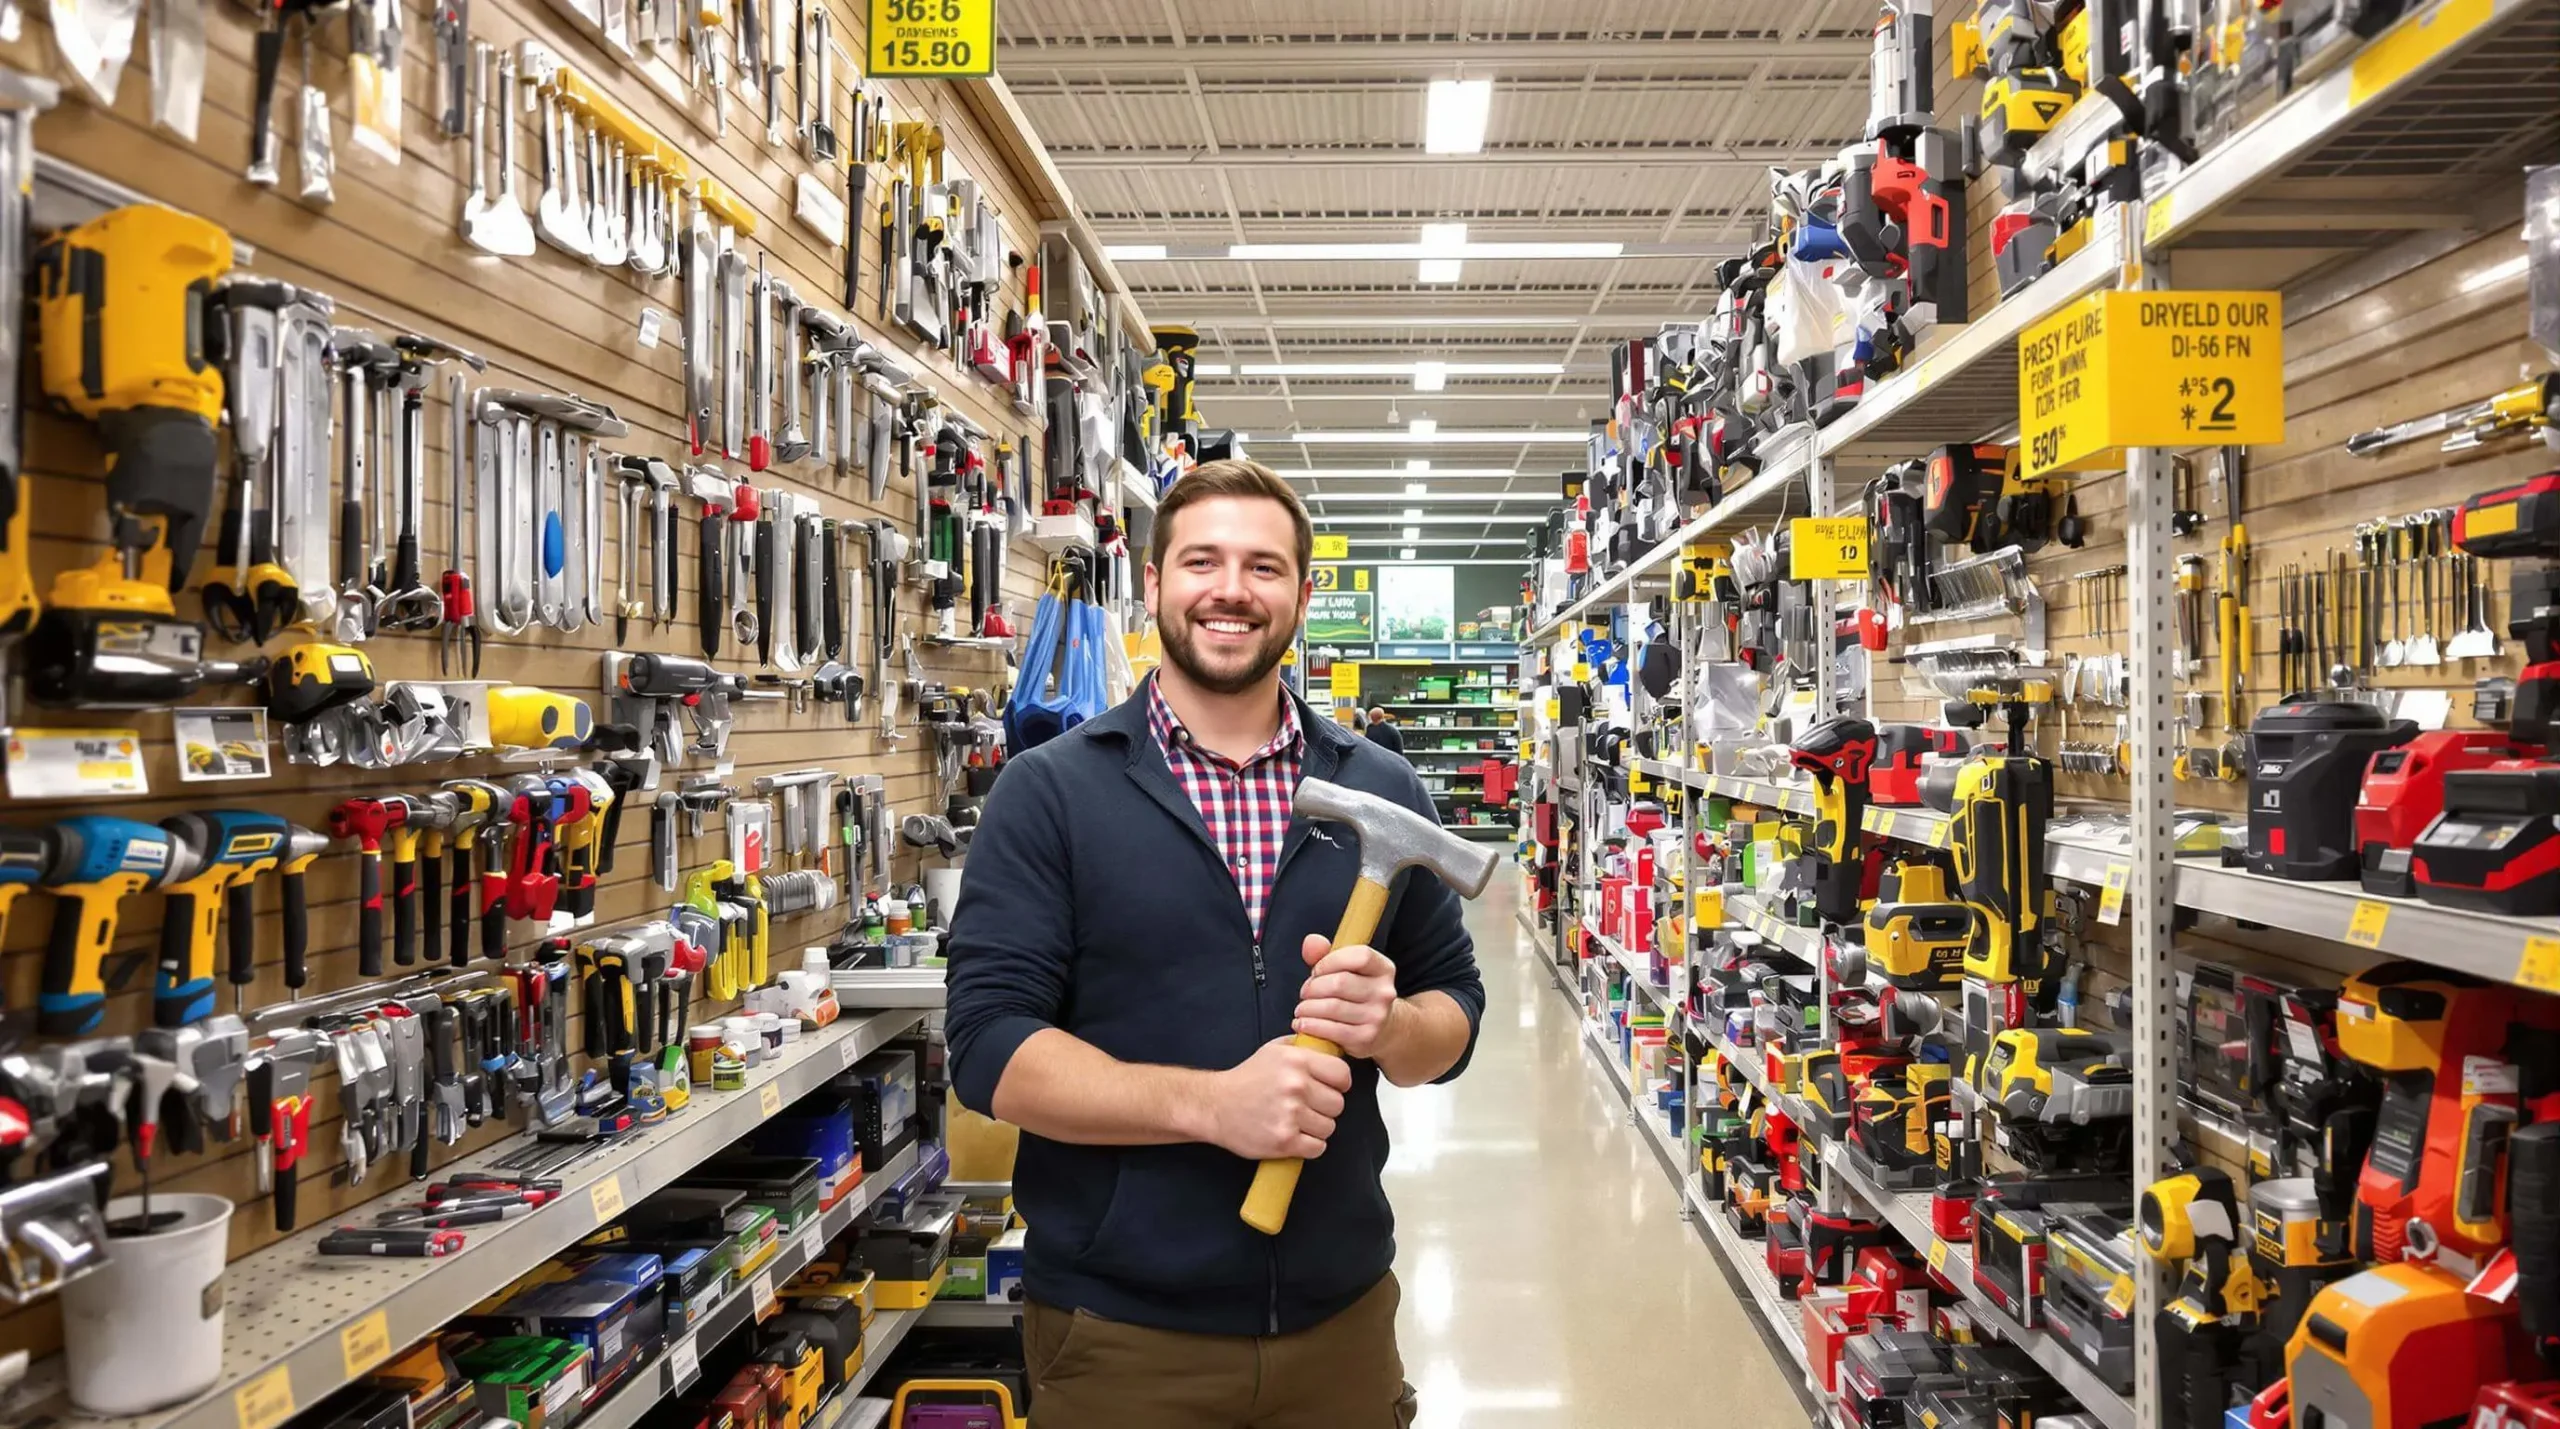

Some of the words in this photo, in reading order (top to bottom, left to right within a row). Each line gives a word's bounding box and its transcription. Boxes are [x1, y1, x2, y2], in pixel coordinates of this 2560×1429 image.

[2141, 302, 2220, 328] DRYELD
[2227, 302, 2270, 328] OUR
[2226, 334, 2252, 358] FN
[2209, 376, 2236, 423] 2
